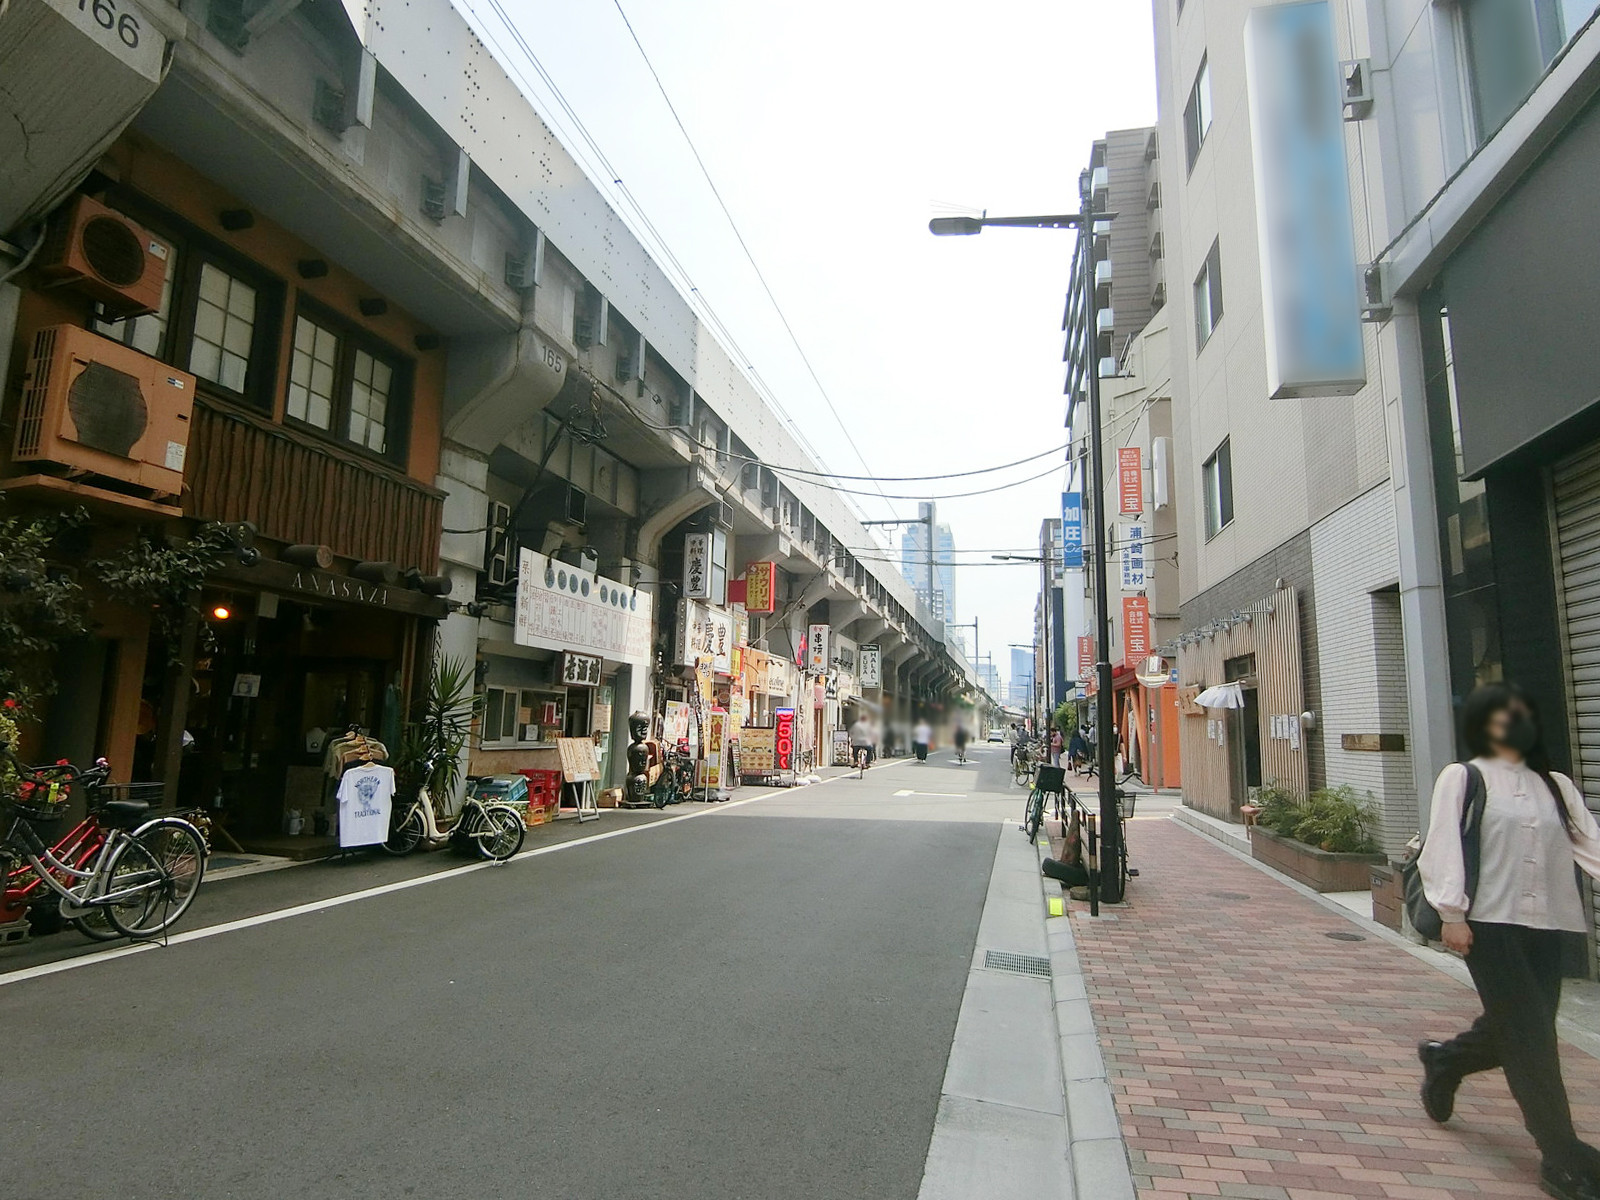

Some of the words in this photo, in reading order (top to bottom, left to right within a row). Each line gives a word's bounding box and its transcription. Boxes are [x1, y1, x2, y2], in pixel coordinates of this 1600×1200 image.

[78, 0, 140, 48] 66
[542, 345, 562, 373] 165
[1064, 506, 1080, 540] 加圧
[292, 572, 388, 605] ANASAZI
[759, 566, 770, 608] サウリヤ
